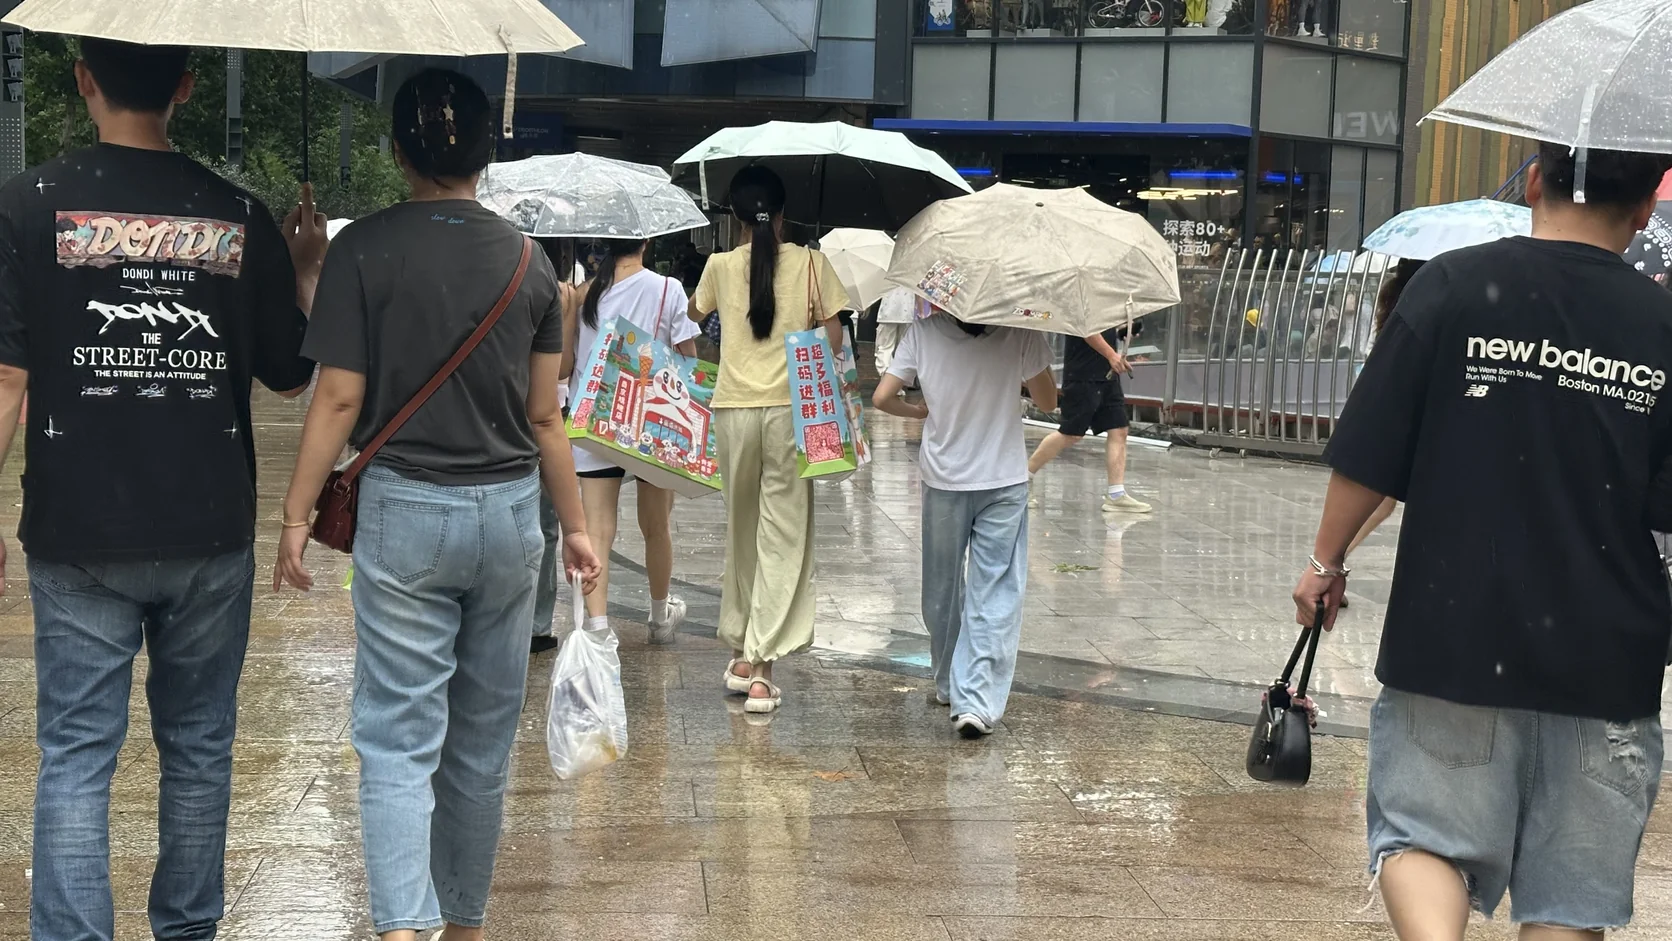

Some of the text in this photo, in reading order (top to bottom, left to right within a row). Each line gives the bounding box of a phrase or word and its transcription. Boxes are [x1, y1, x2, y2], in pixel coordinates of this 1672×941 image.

[1163, 219, 1225, 236] 探索80+
[123, 268, 196, 281] DONDI WHITE
[141, 333, 161, 345] THE
[73, 346, 227, 370] STREET-CORE
[1466, 336, 1666, 391] new balance
[112, 370, 144, 378] STREET
[153, 371, 166, 379] AN
[166, 372, 206, 380] ATTITUDE
[811, 343, 836, 416] 超多福利
[1465, 372, 1507, 383] Run With Us
[1466, 365, 1543, 381] We Were Born To Move
[795, 347, 818, 419] 扫码进群
[1557, 374, 1600, 394] Boston
[1624, 402, 1645, 413] Since
